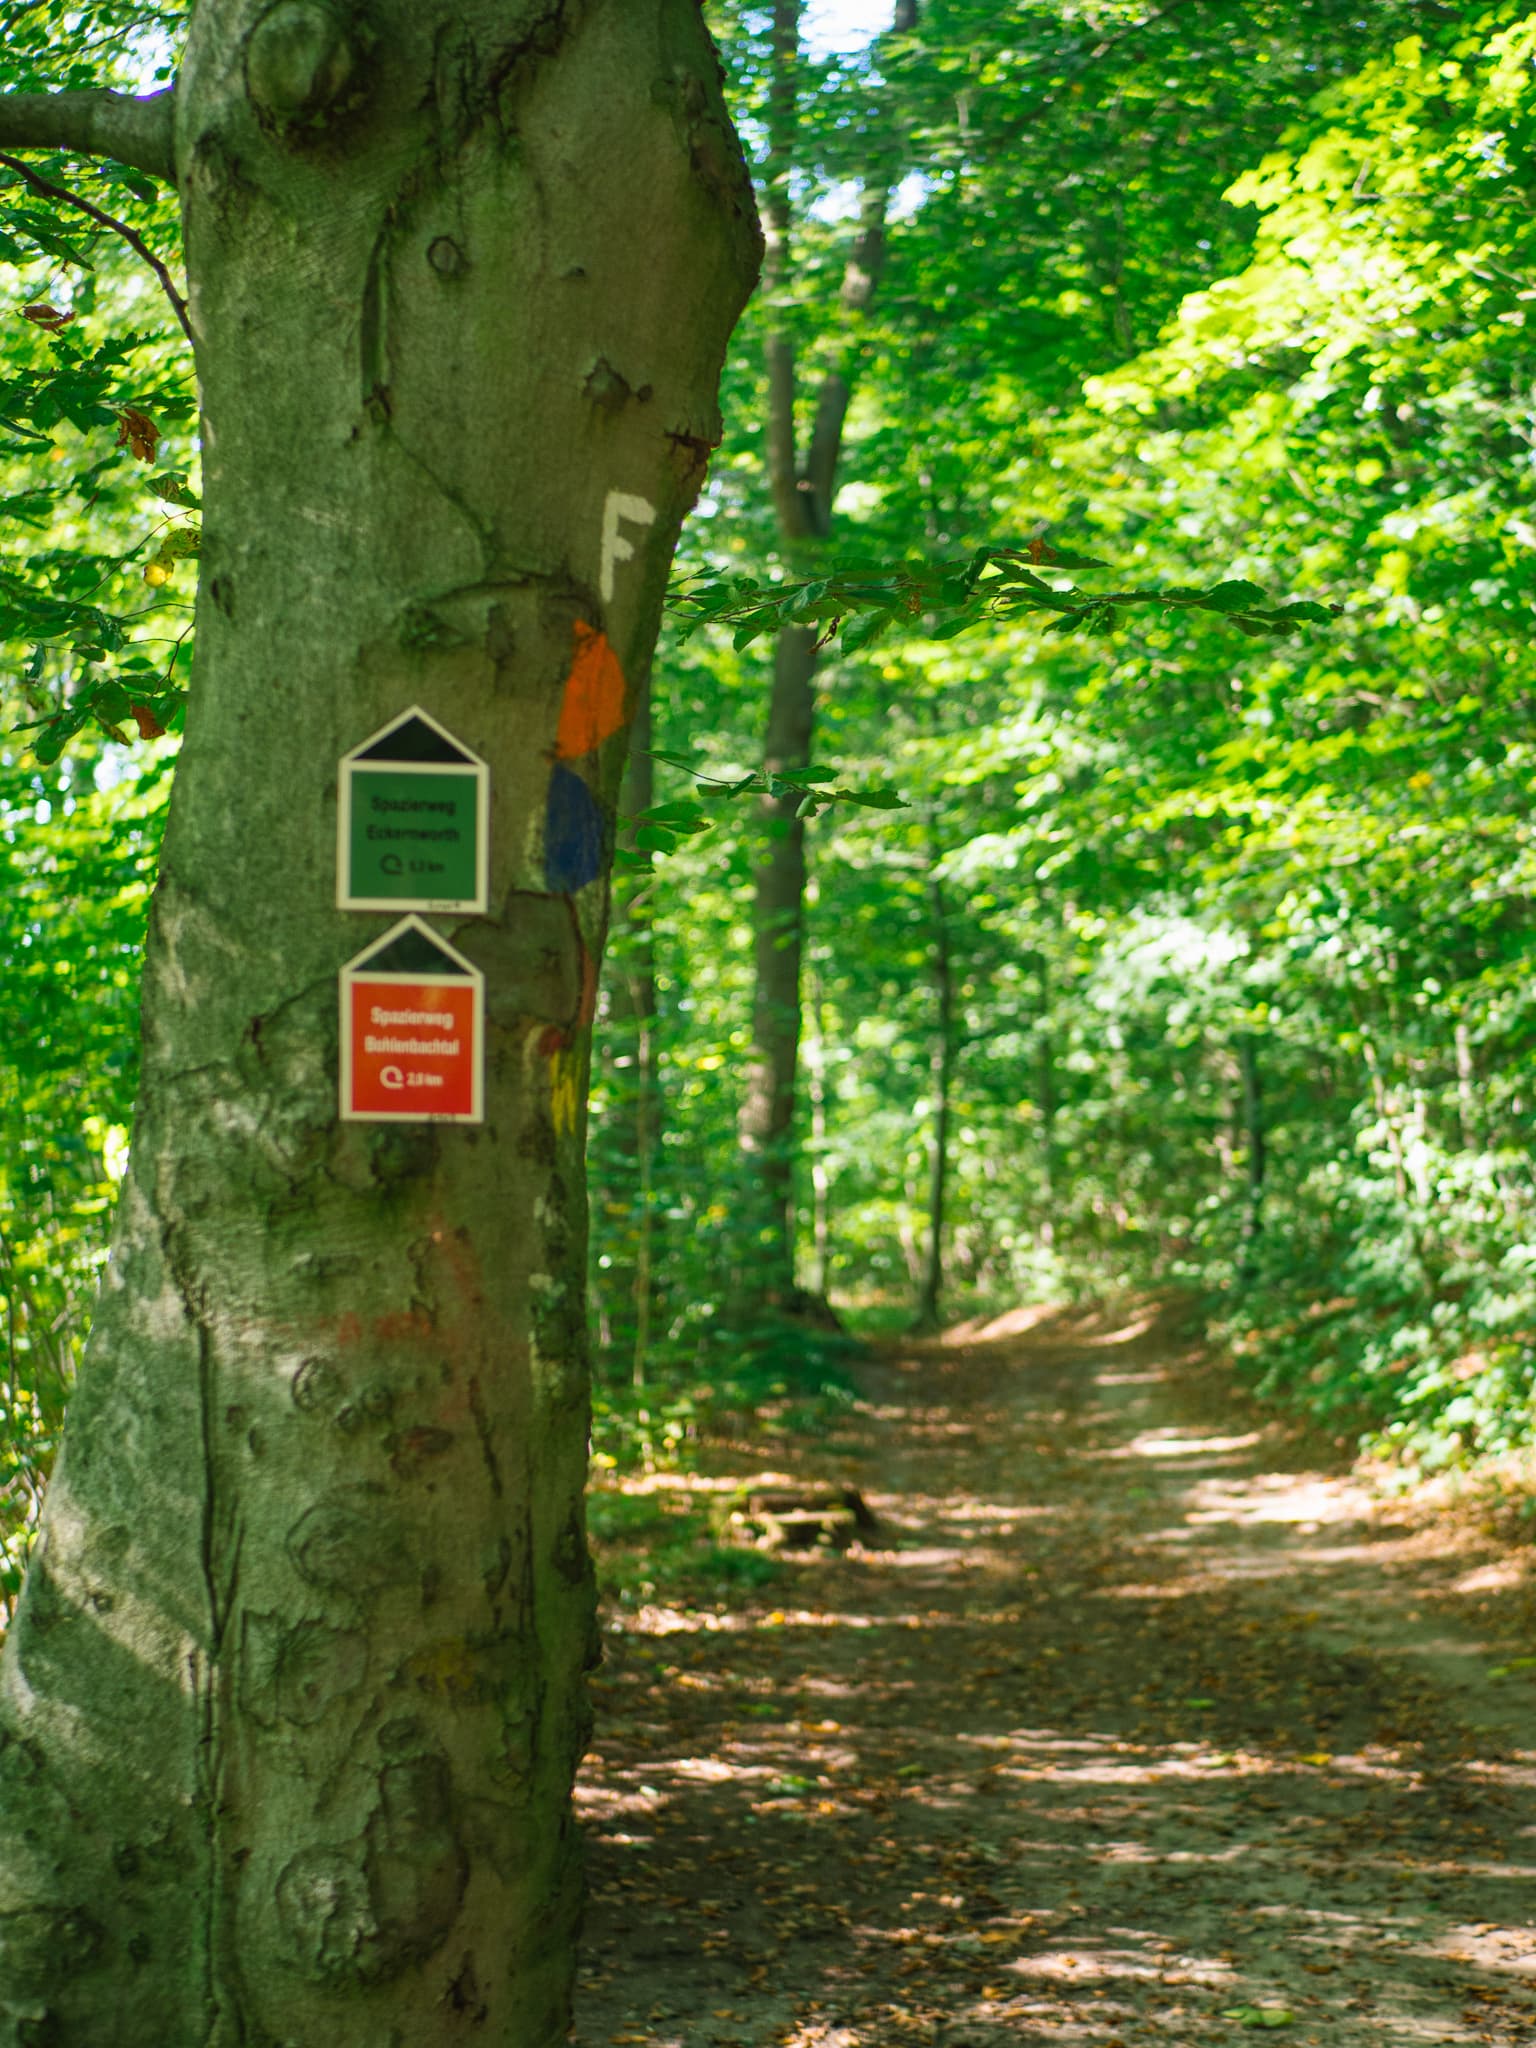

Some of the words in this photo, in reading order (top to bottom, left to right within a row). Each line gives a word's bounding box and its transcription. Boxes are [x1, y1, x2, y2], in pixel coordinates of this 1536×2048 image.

[600, 489, 657, 603] F
[371, 796, 456, 817] Spazierweg
[371, 1006, 454, 1030] Spazierweg
